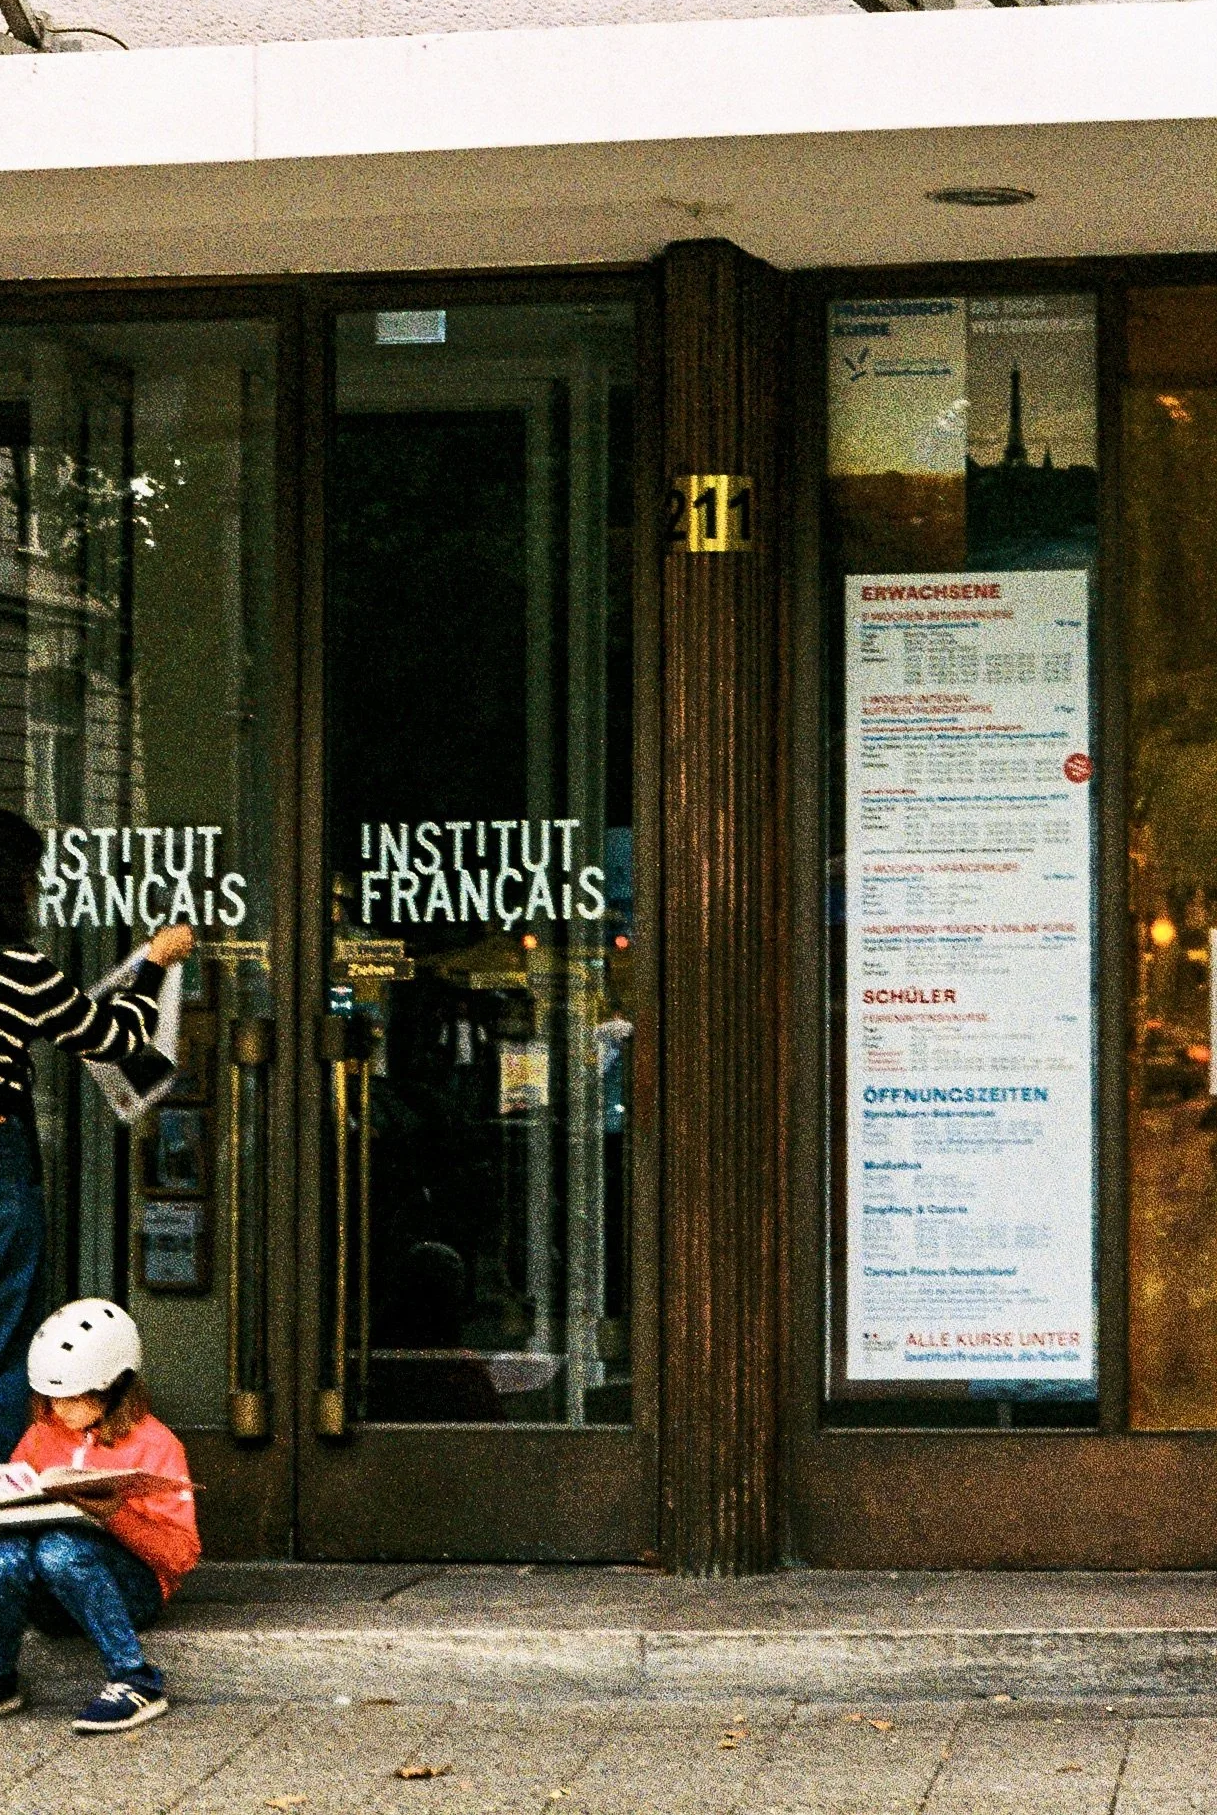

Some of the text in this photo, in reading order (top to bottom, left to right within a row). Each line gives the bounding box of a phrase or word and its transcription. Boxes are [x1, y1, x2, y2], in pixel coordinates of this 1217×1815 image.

[664, 486, 751, 540] 211
[861, 583, 1001, 602] ERWACHSENE
[361, 819, 581, 876] INSTITUT
[862, 985, 957, 1004] SCHÜLER
[862, 1085, 1048, 1103] ÖFFNUNGSZEITEN
[905, 1331, 1081, 1348] ALLE KURSE UNTER
